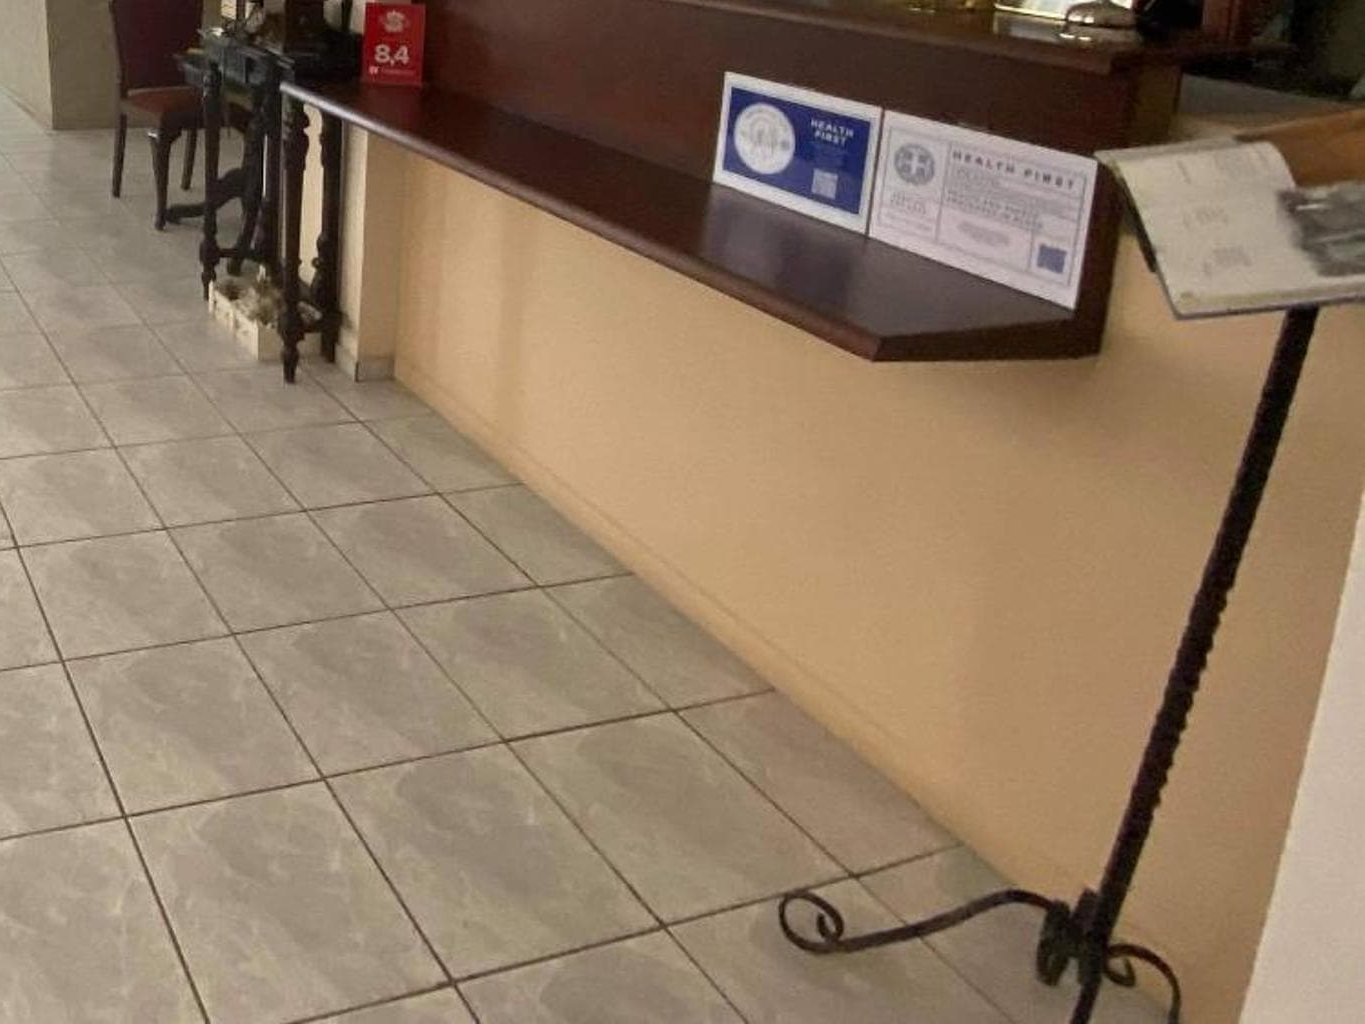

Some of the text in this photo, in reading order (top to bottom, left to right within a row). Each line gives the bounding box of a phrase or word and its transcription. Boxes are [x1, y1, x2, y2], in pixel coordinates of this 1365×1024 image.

[375, 44, 409, 66] 8,4
[811, 119, 854, 137] HEALTH
[815, 130, 847, 146] FIRST
[952, 150, 1015, 174] HEALTH
[1023, 168, 1074, 188] FIRST
